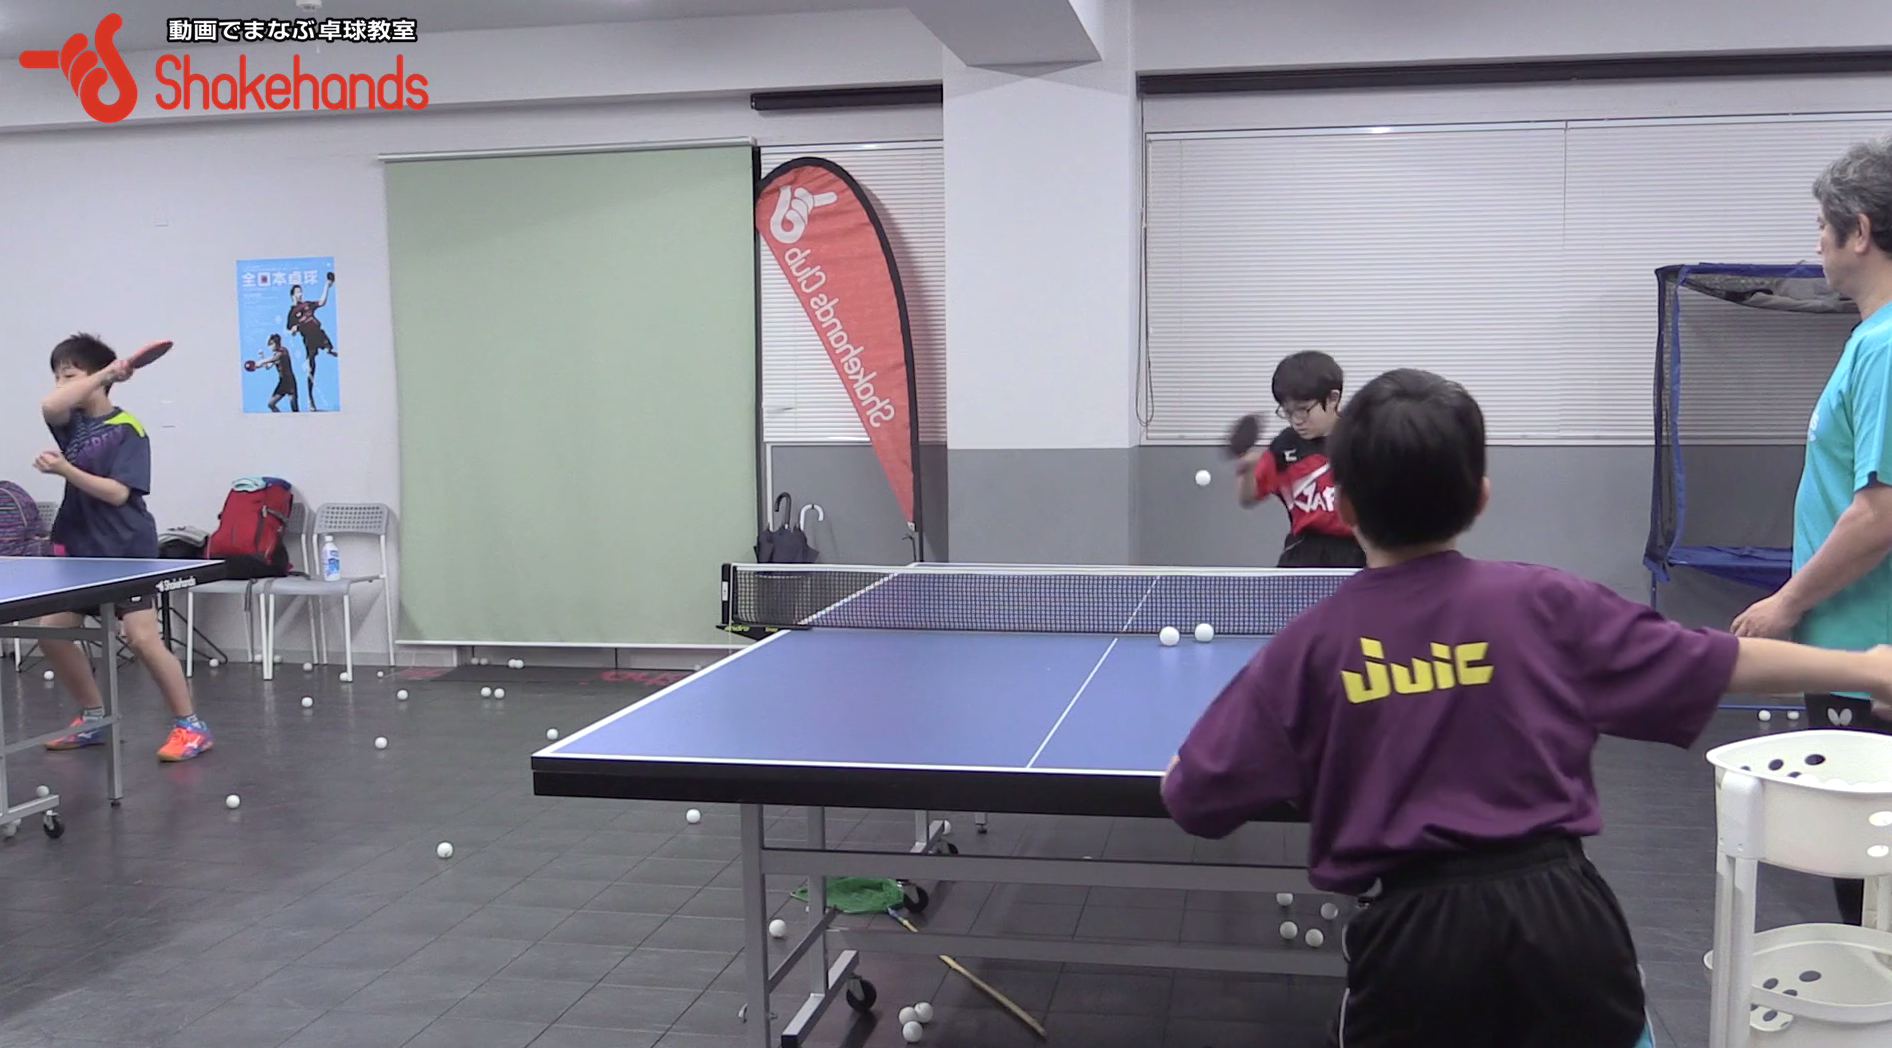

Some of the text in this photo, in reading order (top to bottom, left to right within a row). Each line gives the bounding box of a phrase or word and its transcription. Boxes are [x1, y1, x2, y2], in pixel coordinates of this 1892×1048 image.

[242, 270, 318, 287] 全日本卓球
[1340, 636, 1494, 703] juic
